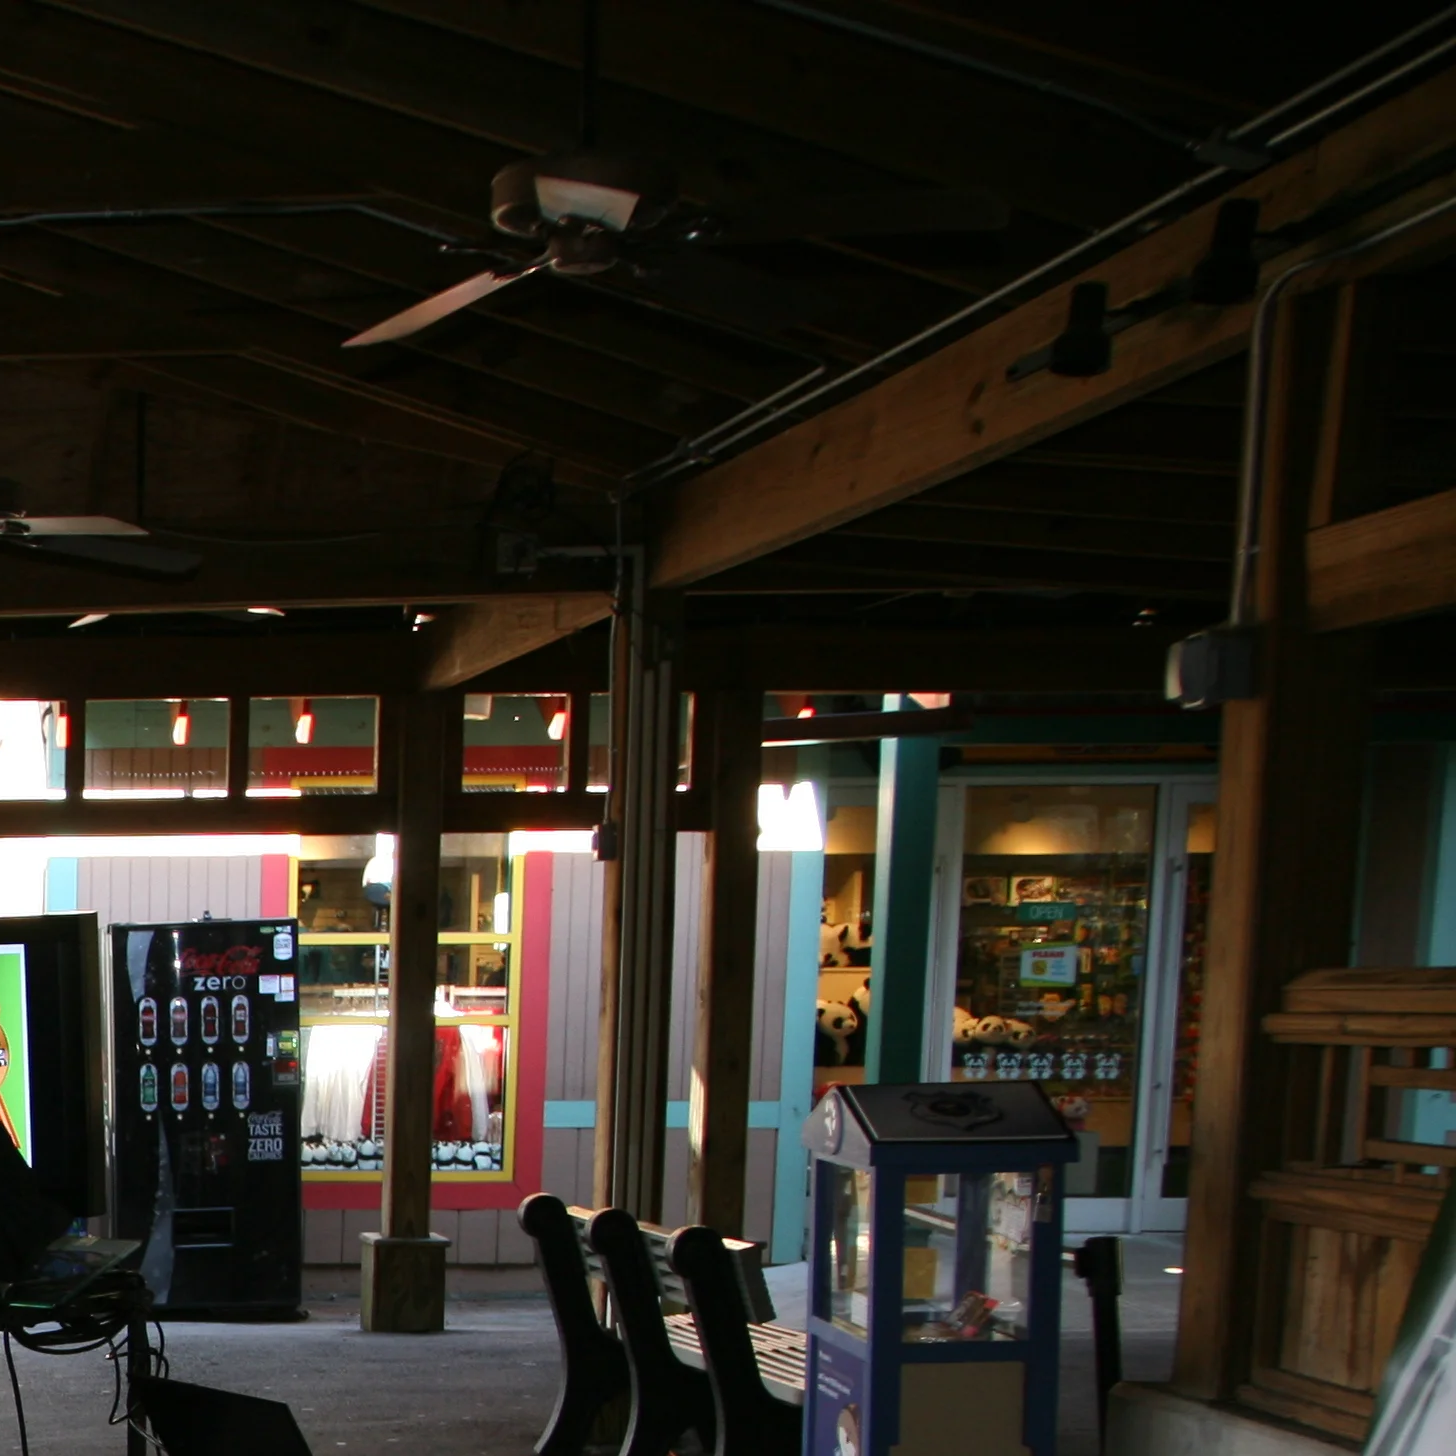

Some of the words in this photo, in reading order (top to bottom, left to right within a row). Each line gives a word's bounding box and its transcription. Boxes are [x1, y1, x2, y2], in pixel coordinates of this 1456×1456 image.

[1030, 904, 1065, 919] OPEN
[193, 975, 246, 991] zero
[248, 1124, 283, 1136] TASTE
[248, 1138, 283, 1151] ZERO
